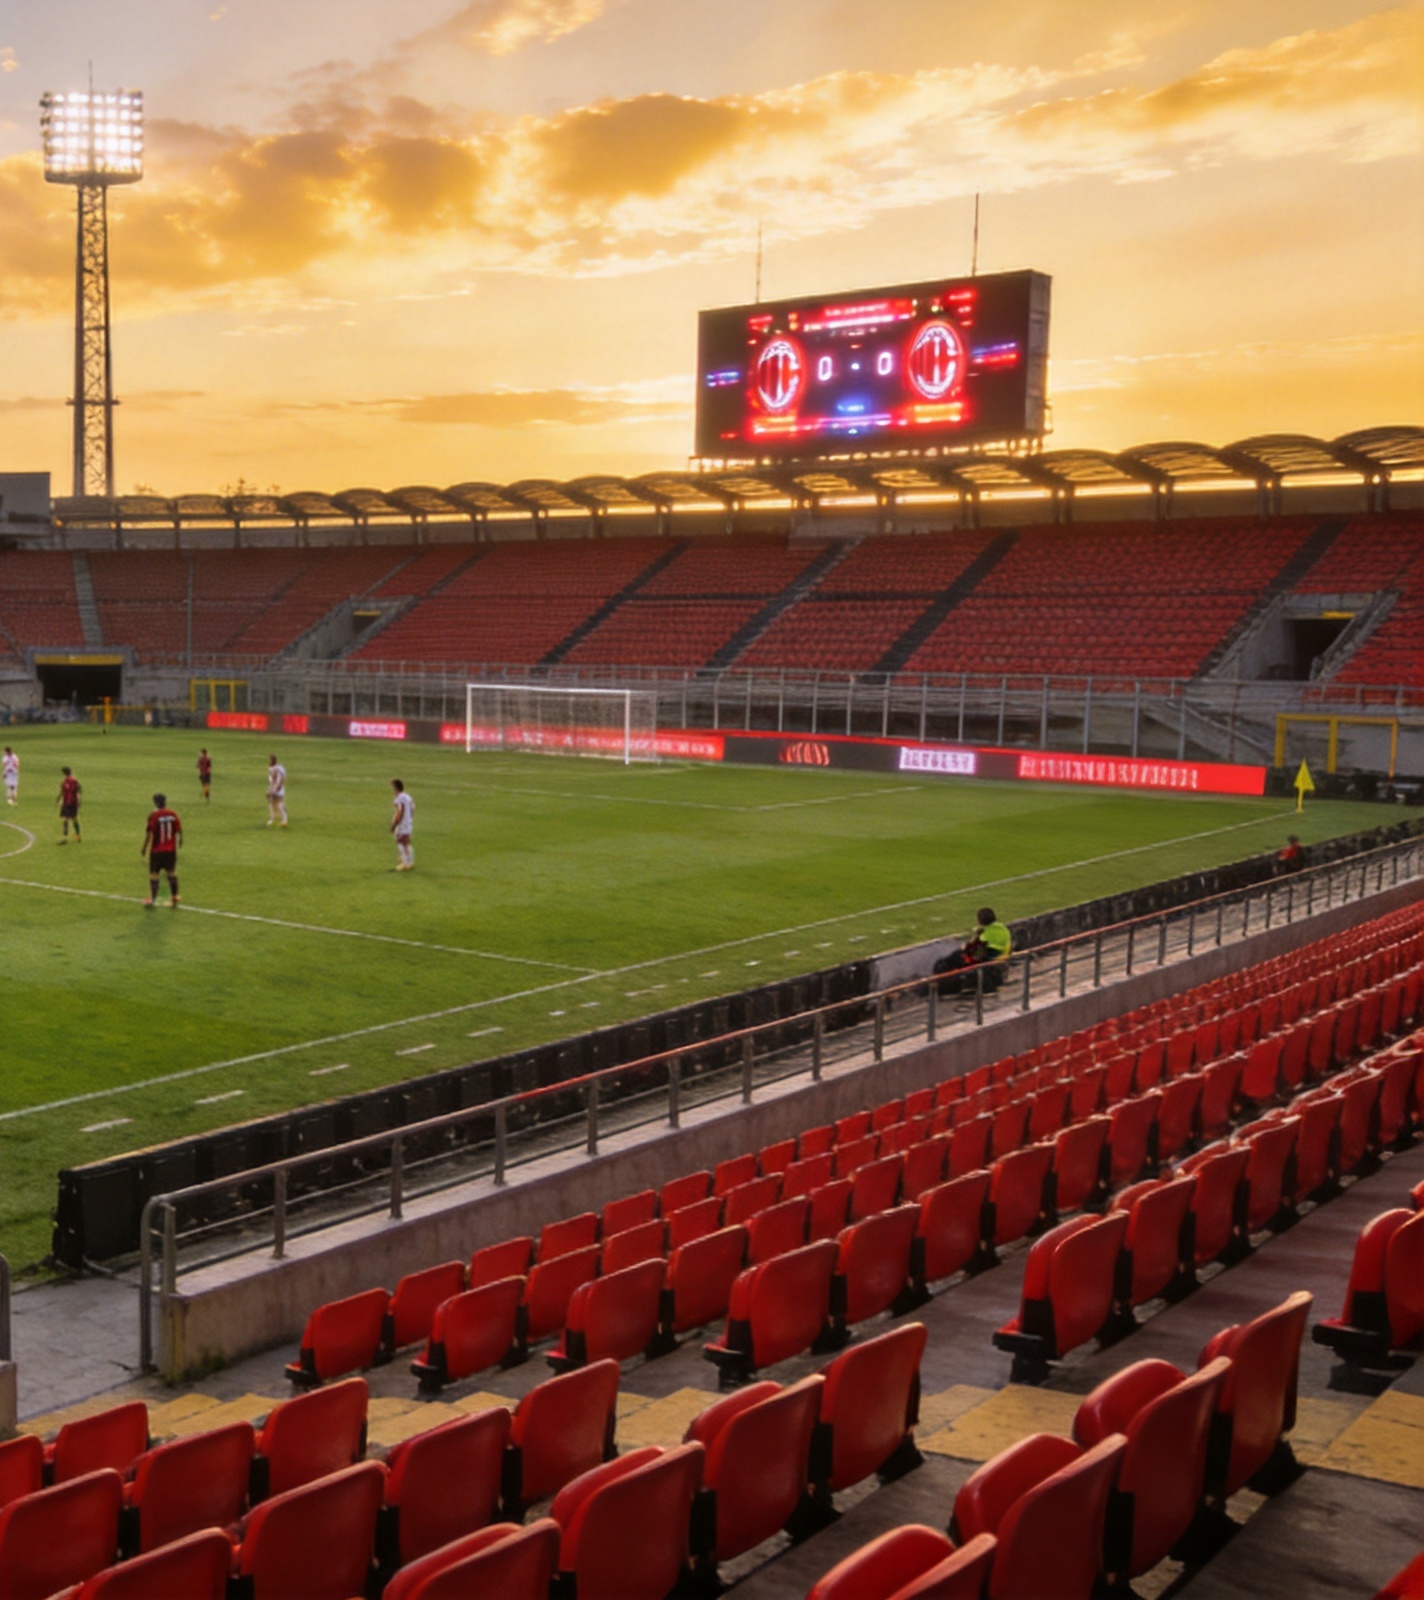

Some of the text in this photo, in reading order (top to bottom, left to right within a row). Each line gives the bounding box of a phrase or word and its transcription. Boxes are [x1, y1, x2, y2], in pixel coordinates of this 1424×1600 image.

[818, 352, 893, 381] 0 0
[160, 821, 173, 843] 11
